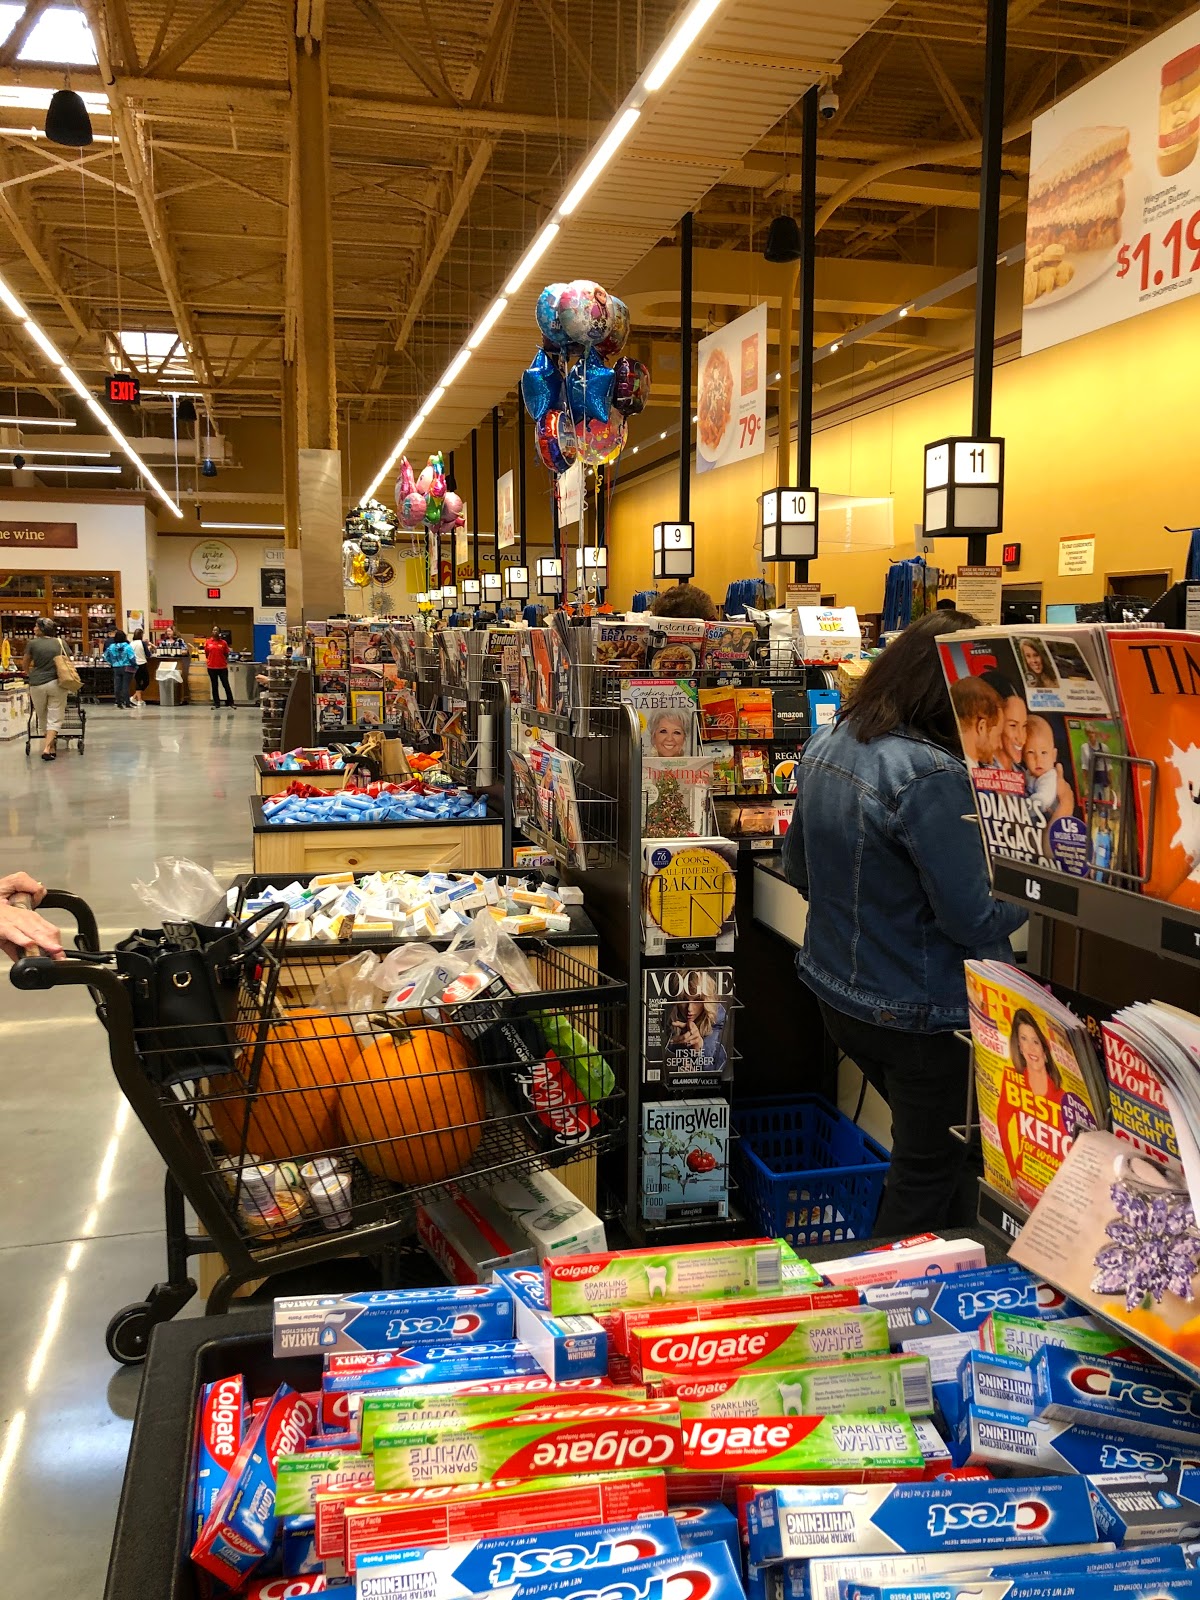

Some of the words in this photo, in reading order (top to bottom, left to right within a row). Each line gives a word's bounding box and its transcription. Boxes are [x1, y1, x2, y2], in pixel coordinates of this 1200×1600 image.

[110, 380, 135, 401] EXIT
[969, 448, 985, 473] 11
[791, 496, 806, 514] 10
[13, 529, 45, 541] wine
[674, 528, 682, 543] 9
[1004, 546, 1016, 562] EXIT
[549, 561, 554, 571] 7
[516, 569, 521, 579] 6
[601, 628, 627, 636] EASY
[657, 623, 686, 632] Instant
[623, 696, 695, 709] DIABETES
[777, 711, 804, 720] amazon
[778, 809, 793, 817] NETF
[978, 791, 1047, 828] DIANA'S
[1061, 818, 1079, 833] Us
[984, 819, 1044, 856] LEGACY
[657, 852, 667, 860] 76
[675, 855, 710, 866] COOK'S
[664, 866, 700, 876] ALL-TIME
[701, 866, 720, 874] BEST
[658, 874, 723, 893] BAKING
[1025, 878, 1042, 899] Us
[649, 970, 735, 998] VOGUE
[690, 1048, 705, 1058] THE
[666, 1056, 715, 1067] SEPTEMBER
[1006, 1069, 1026, 1086] THE
[1005, 1080, 1062, 1128] BEST
[1067, 1094, 1089, 1116] Drop
[1109, 1090, 1151, 1127] BLOCK
[647, 1106, 727, 1134] EatingWell
[1063, 1106, 1074, 1119] 15
[1111, 1106, 1162, 1147] WEIGHT
[646, 1197, 664, 1207] FOOD
[554, 1264, 600, 1278] Colgate
[584, 1279, 627, 1290] SPARKLING
[370, 1287, 492, 1302] Crest
[584, 1286, 629, 1301] WHITE
[959, 1284, 1066, 1320] Crest
[281, 1326, 320, 1334] PROTECTION
[385, 1313, 482, 1341] Crest
[809, 1325, 861, 1338] SPARKLING
[281, 1332, 319, 1348] TARTAR
[564, 1337, 597, 1348] Crest
[810, 1333, 864, 1353] WHITE
[567, 1350, 596, 1361] WHITENING
[650, 1332, 767, 1366] Colgate
[676, 1382, 729, 1397] Colgate
[978, 1372, 1034, 1397] WHITENING
[979, 1387, 1008, 1400] PROTECTION
[509, 1402, 671, 1423] Colgate
[711, 1399, 758, 1411] SPARKLING
[215, 1381, 241, 1456] Colgate
[832, 1424, 902, 1436] SPARKLING
[978, 1423, 1037, 1446] WHITENING
[530, 1430, 675, 1469] Colgate
[833, 1434, 908, 1452] WHITE
[979, 1439, 1013, 1452] PROTECTION
[409, 1443, 479, 1466] WHITE
[1013, 1445, 1037, 1457] TARTAR
[412, 1461, 478, 1477] SPARKLING
[1107, 1490, 1152, 1499] PROTECTION
[1114, 1495, 1163, 1512] TARTAR
[786, 1511, 855, 1534] WHITENING
[927, 1500, 1050, 1537] Crest
[222, 1527, 257, 1554] Colgate
[789, 1534, 830, 1545] PROTECTION
[830, 1533, 856, 1543] TARTAR
[489, 1538, 657, 1587] Crest
[361, 1571, 437, 1597] WHITENING
[1113, 1583, 1143, 1592] TOOTHPASTE
